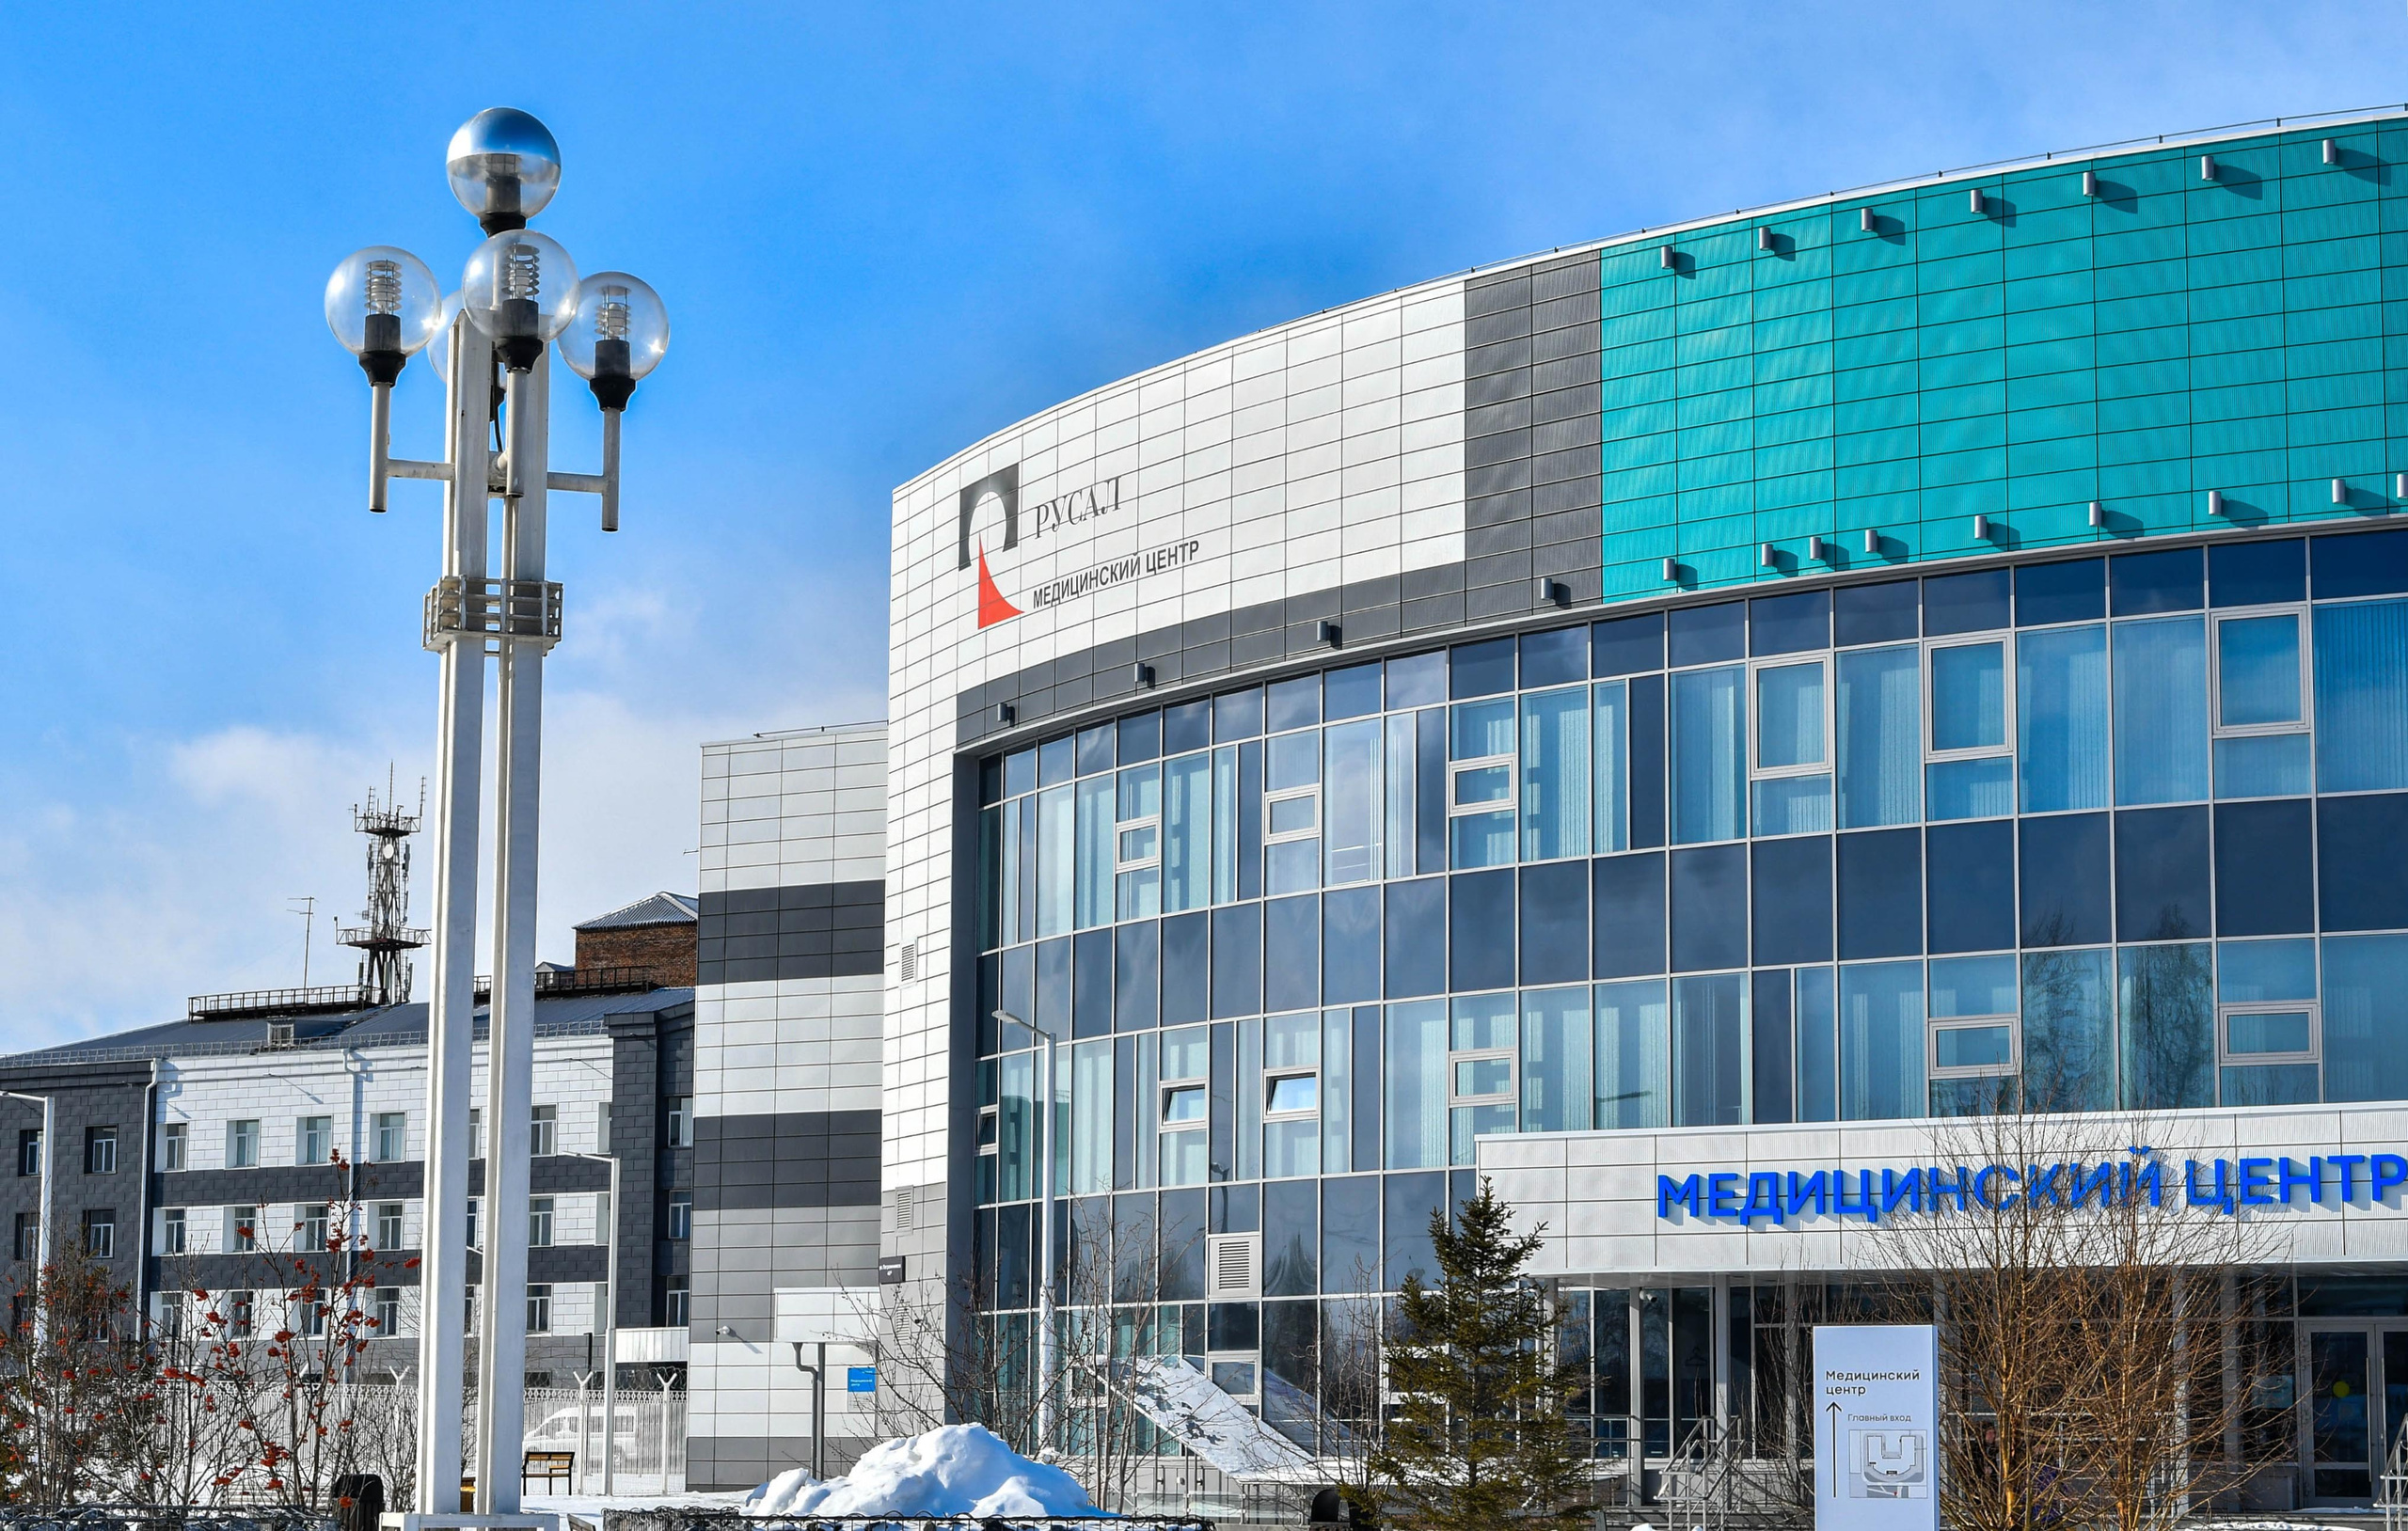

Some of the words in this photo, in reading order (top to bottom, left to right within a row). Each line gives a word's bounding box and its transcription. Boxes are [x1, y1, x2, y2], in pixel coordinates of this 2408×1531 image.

[1035, 475, 1122, 540] РУСАЛ
[1033, 552, 1141, 609] МЕДИЦИНСКИЙ
[1146, 540, 1199, 576] ЦЕНТР
[1657, 1145, 2162, 1226] МЕДИЦИНСКИЙ
[2185, 1154, 2408, 1215] ЦЕНТР
[1826, 1369, 1920, 1381] Медицинский
[1826, 1386, 1866, 1397] центр
[1847, 1413, 1888, 1422] Главный
